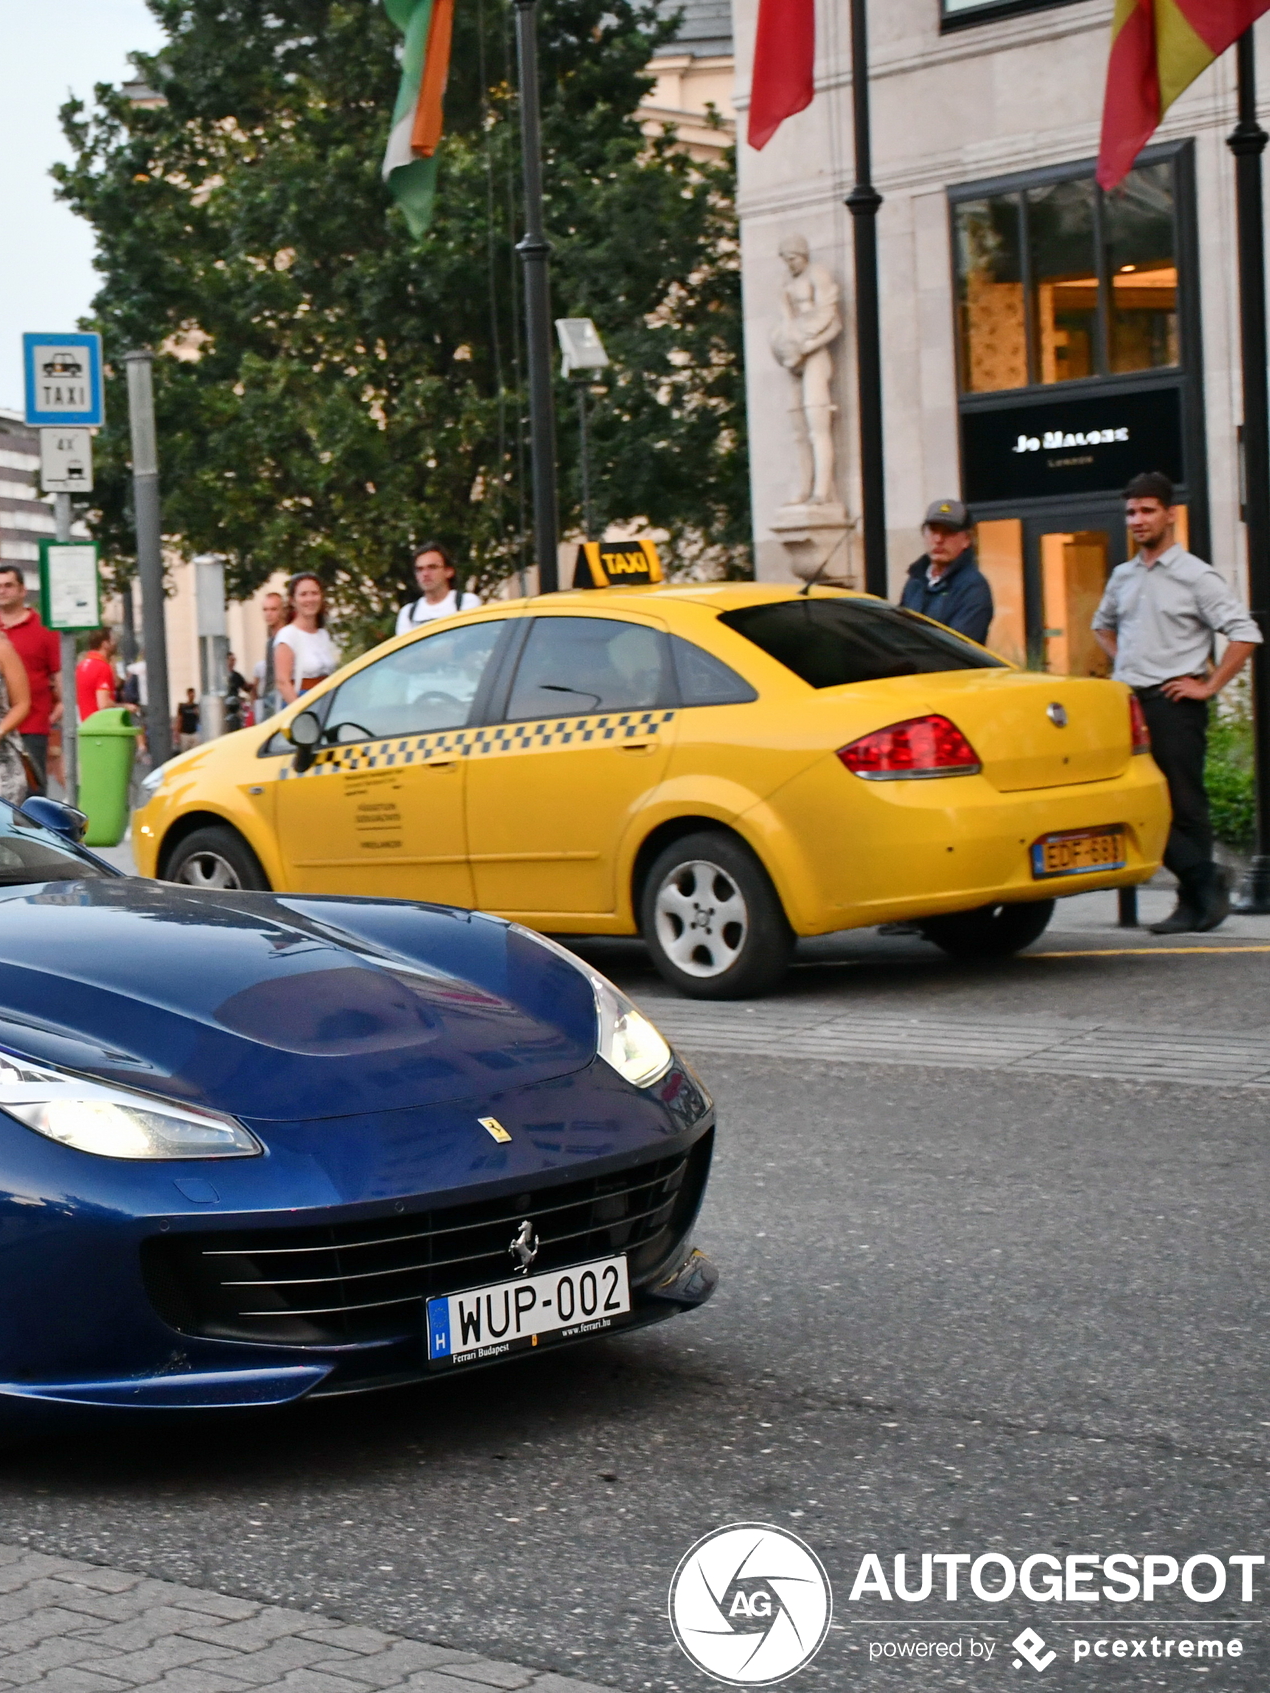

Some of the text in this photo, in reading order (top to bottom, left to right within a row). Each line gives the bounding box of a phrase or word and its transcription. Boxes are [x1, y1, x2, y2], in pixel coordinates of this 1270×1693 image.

[43, 386, 85, 405] TAXI
[601, 551, 649, 575] TAXI
[458, 1265, 621, 1346] WUP-002
[561, 1317, 612, 1338] www.ferrari.hu
[435, 1332, 446, 1351] H
[452, 1342, 510, 1364] Ferrari Budapest
